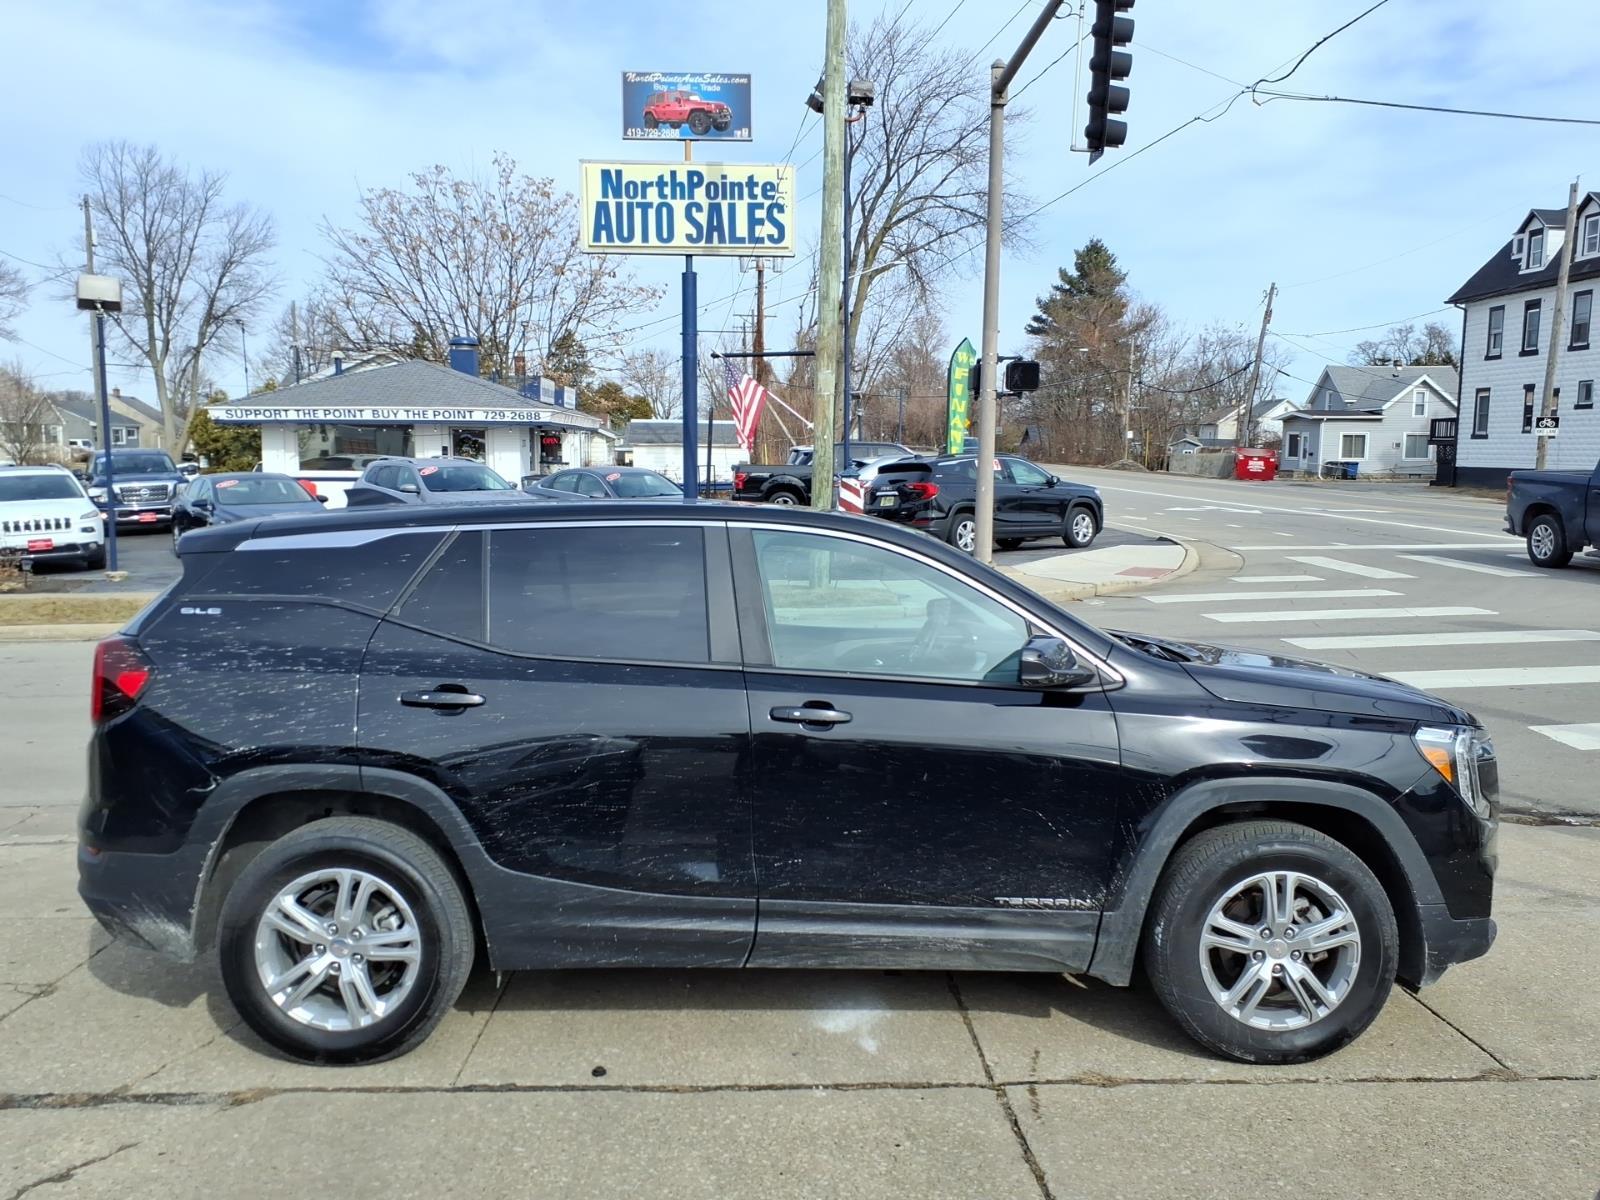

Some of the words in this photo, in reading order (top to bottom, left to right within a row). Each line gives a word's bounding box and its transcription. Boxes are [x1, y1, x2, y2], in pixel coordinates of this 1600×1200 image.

[625, 72, 748, 84] NorthPointeAutoSales.com
[700, 84, 721, 92] Trade
[600, 168, 776, 201] NorthPointe
[592, 201, 675, 244] AUTO
[684, 201, 786, 245] SALES
[225, 409, 290, 419] SUPPORT
[294, 409, 319, 419] THE
[323, 409, 364, 419] POINT
[372, 409, 399, 420] BUY
[403, 409, 429, 420] THE
[433, 409, 475, 420] POINT
[483, 410, 541, 421] 729-2688
